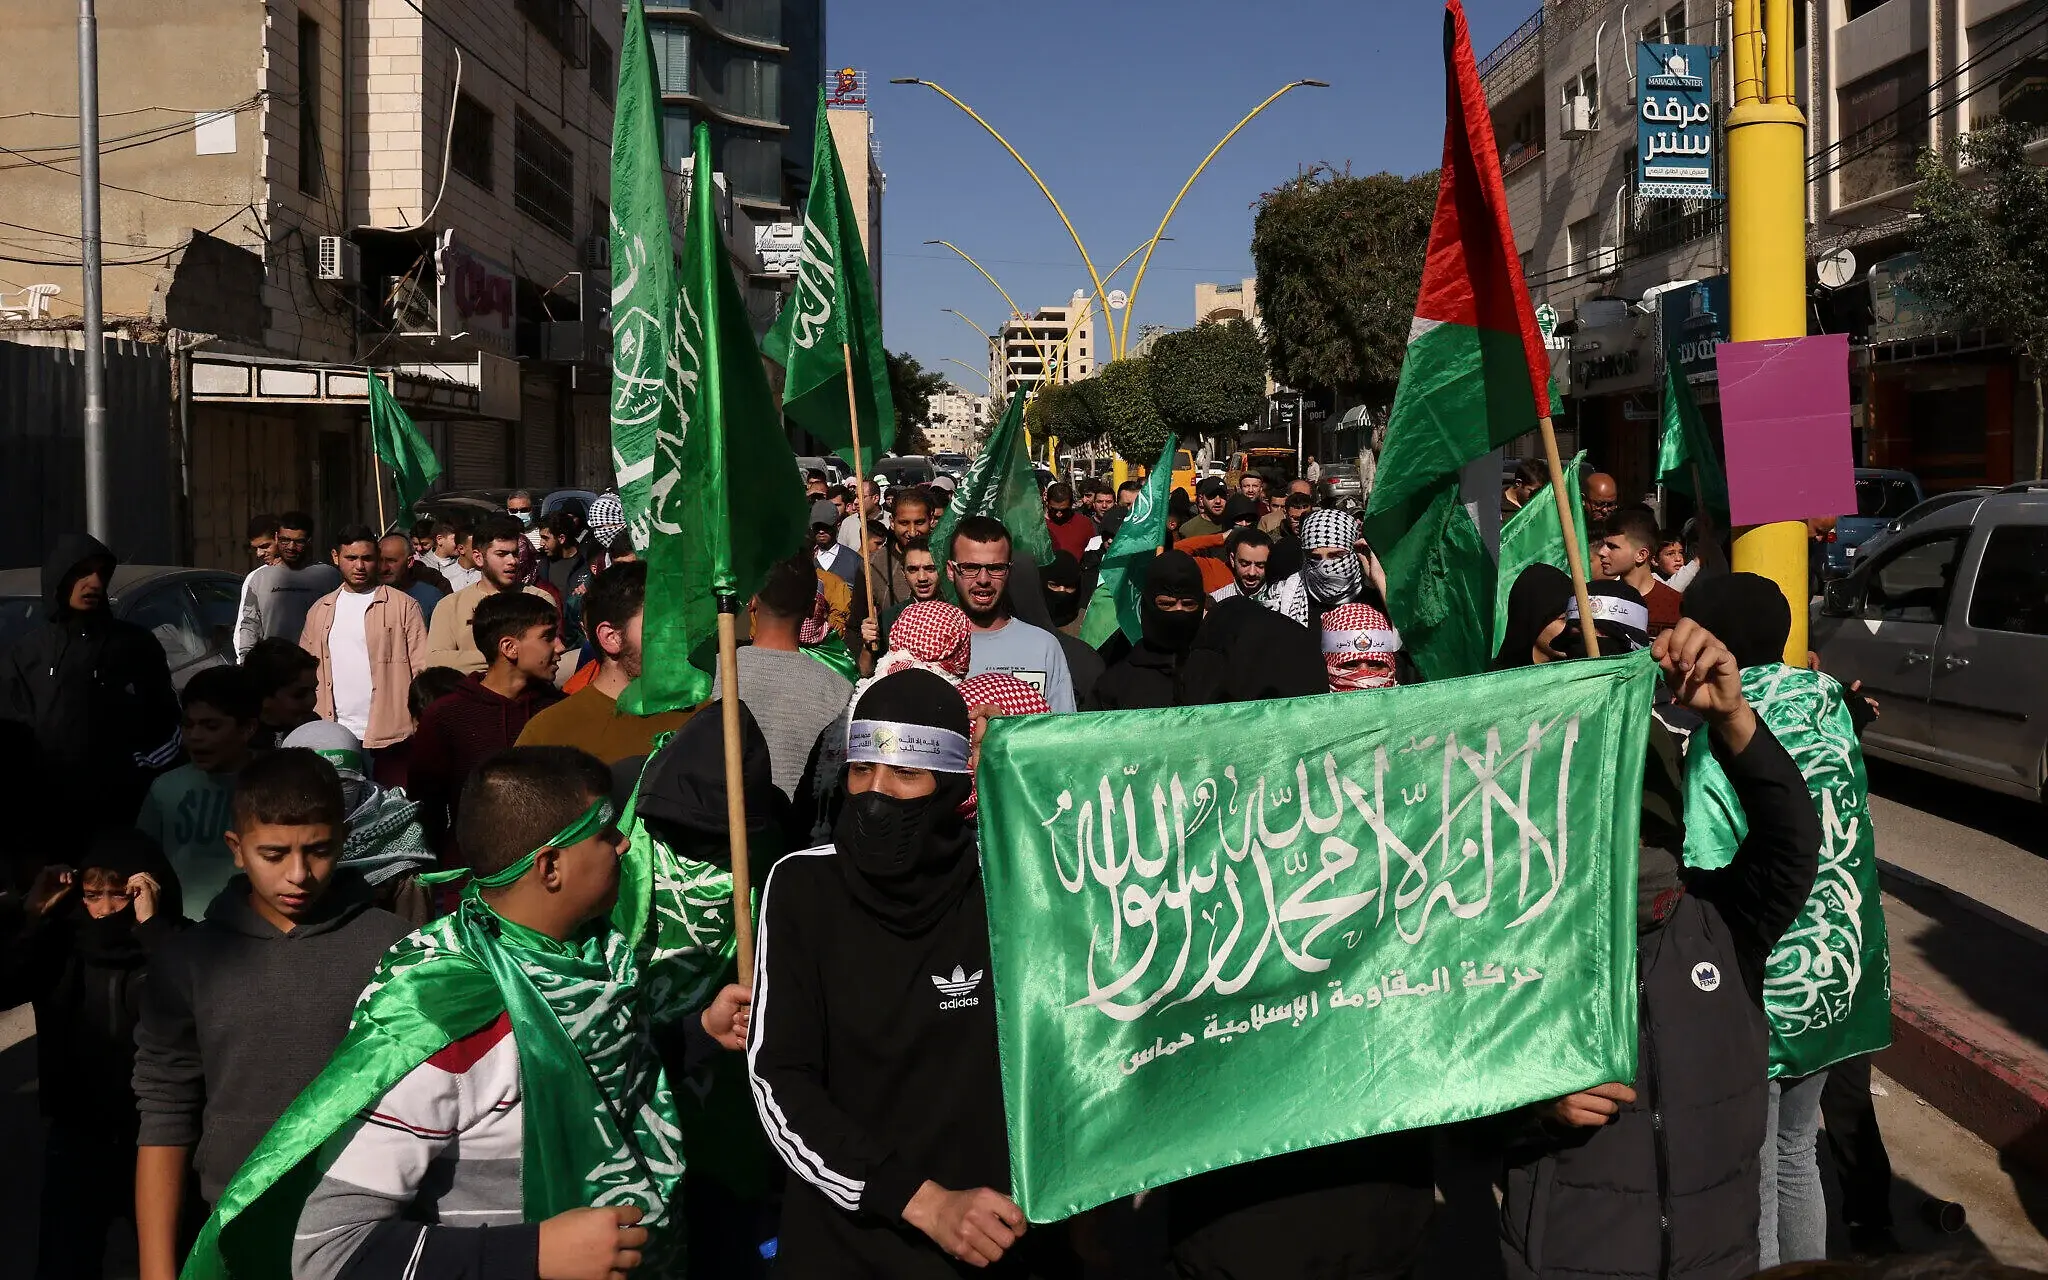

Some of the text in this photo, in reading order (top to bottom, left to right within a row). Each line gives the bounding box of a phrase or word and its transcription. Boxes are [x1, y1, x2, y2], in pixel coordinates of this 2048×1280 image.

[1648, 78, 1677, 86] MARAQA
[1643, 96, 1710, 129] مرقة
[1644, 132, 1710, 161] سنتر
[174, 787, 231, 845] SU
[1327, 965, 1450, 1009] المقاومة
[1460, 960, 1543, 991] حركة
[1699, 978, 1717, 987] FENG
[939, 997, 979, 1010] adidas
[1118, 1031, 1195, 1076] حماس
